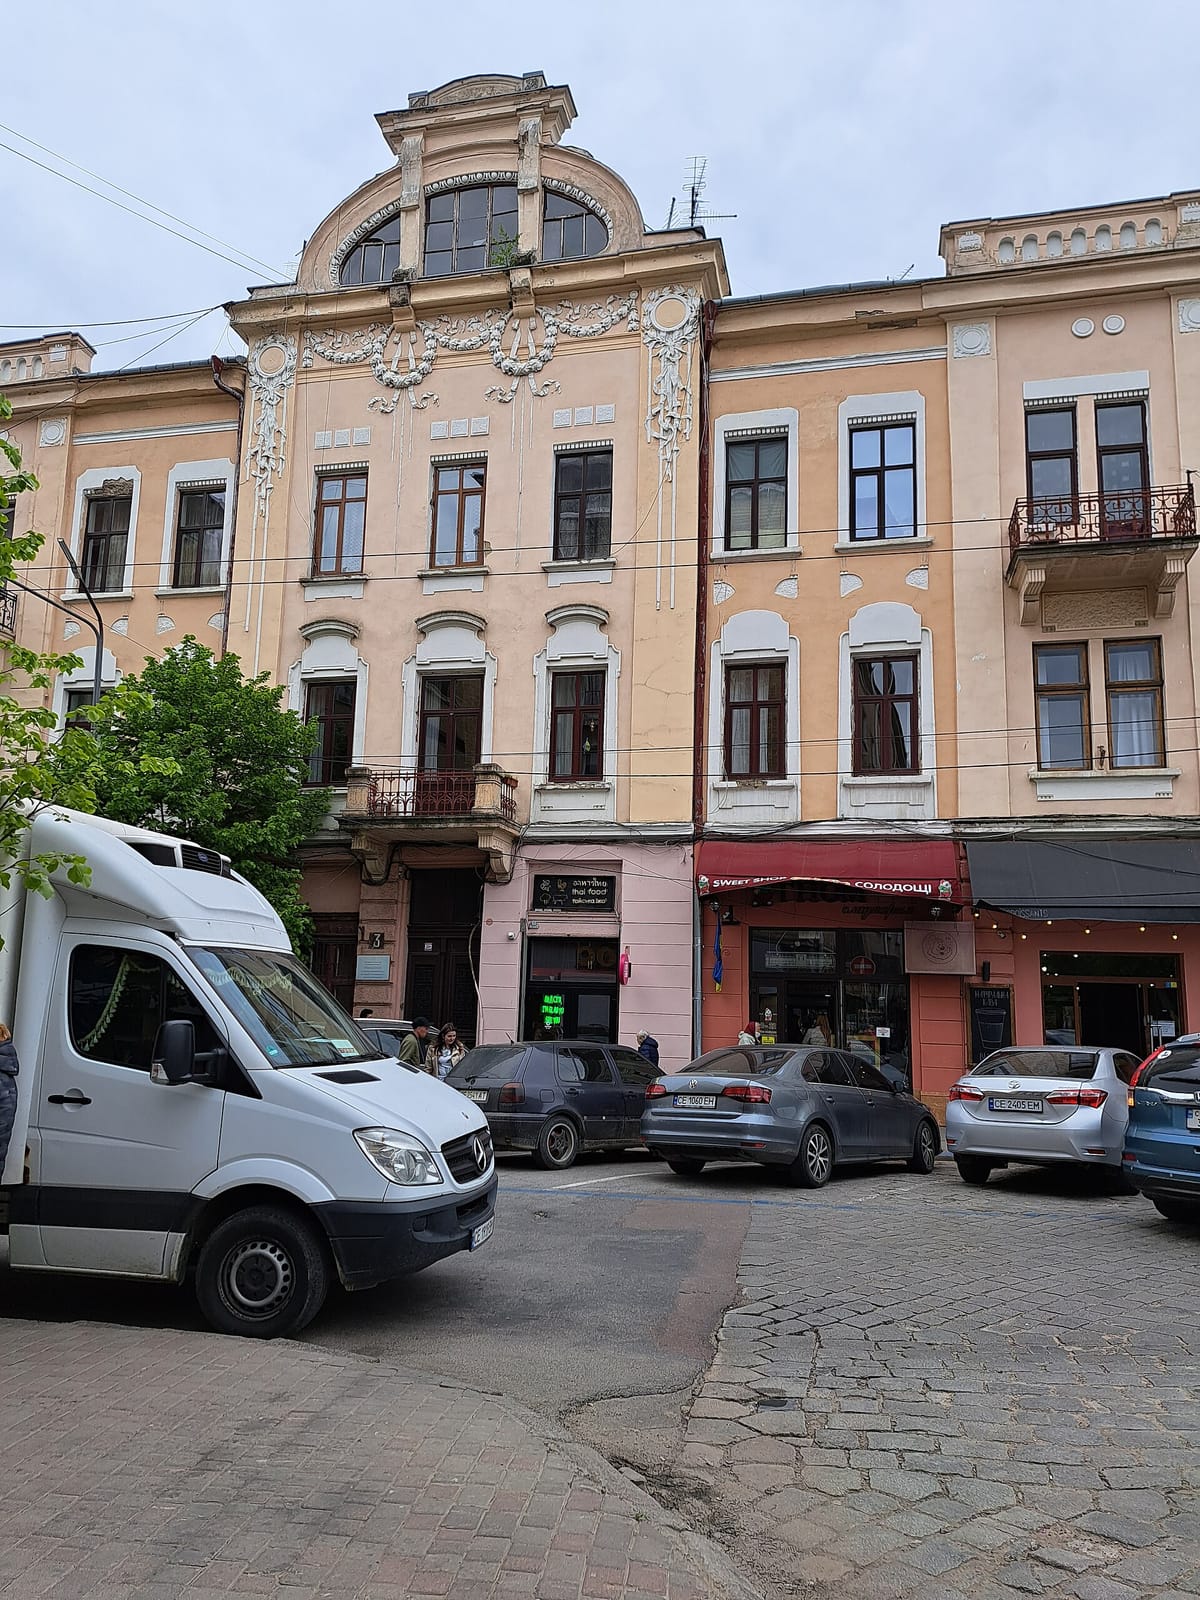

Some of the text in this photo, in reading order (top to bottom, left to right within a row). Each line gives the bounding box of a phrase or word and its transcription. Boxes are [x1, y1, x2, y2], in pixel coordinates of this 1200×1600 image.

[712, 879, 750, 887] SWEET
[855, 881, 932, 895] СОЛОДОЩІ
[588, 887, 607, 896] food
[373, 933, 381, 948] 3
[677, 1096, 687, 1105] CE
[703, 1097, 714, 1106] EH
[994, 1100, 1040, 1110] CE 2405 EM
